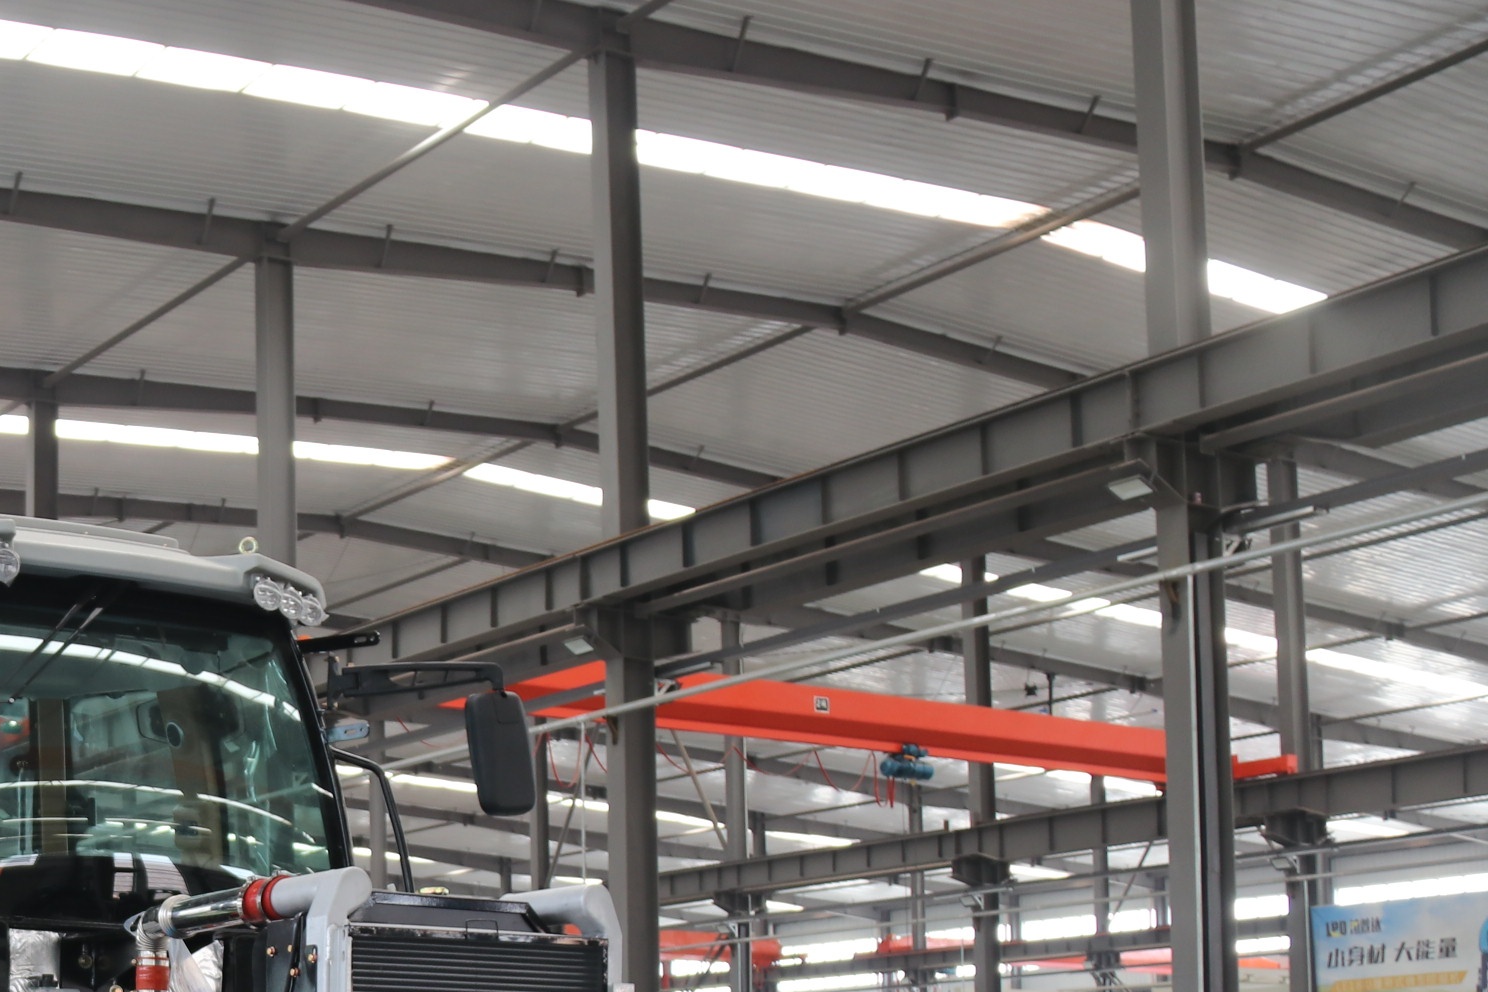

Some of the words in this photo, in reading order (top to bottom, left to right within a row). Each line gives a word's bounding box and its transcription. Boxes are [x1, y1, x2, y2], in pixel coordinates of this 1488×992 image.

[1326, 943, 1387, 969] 小身材
[1395, 936, 1458, 962] 大能量
